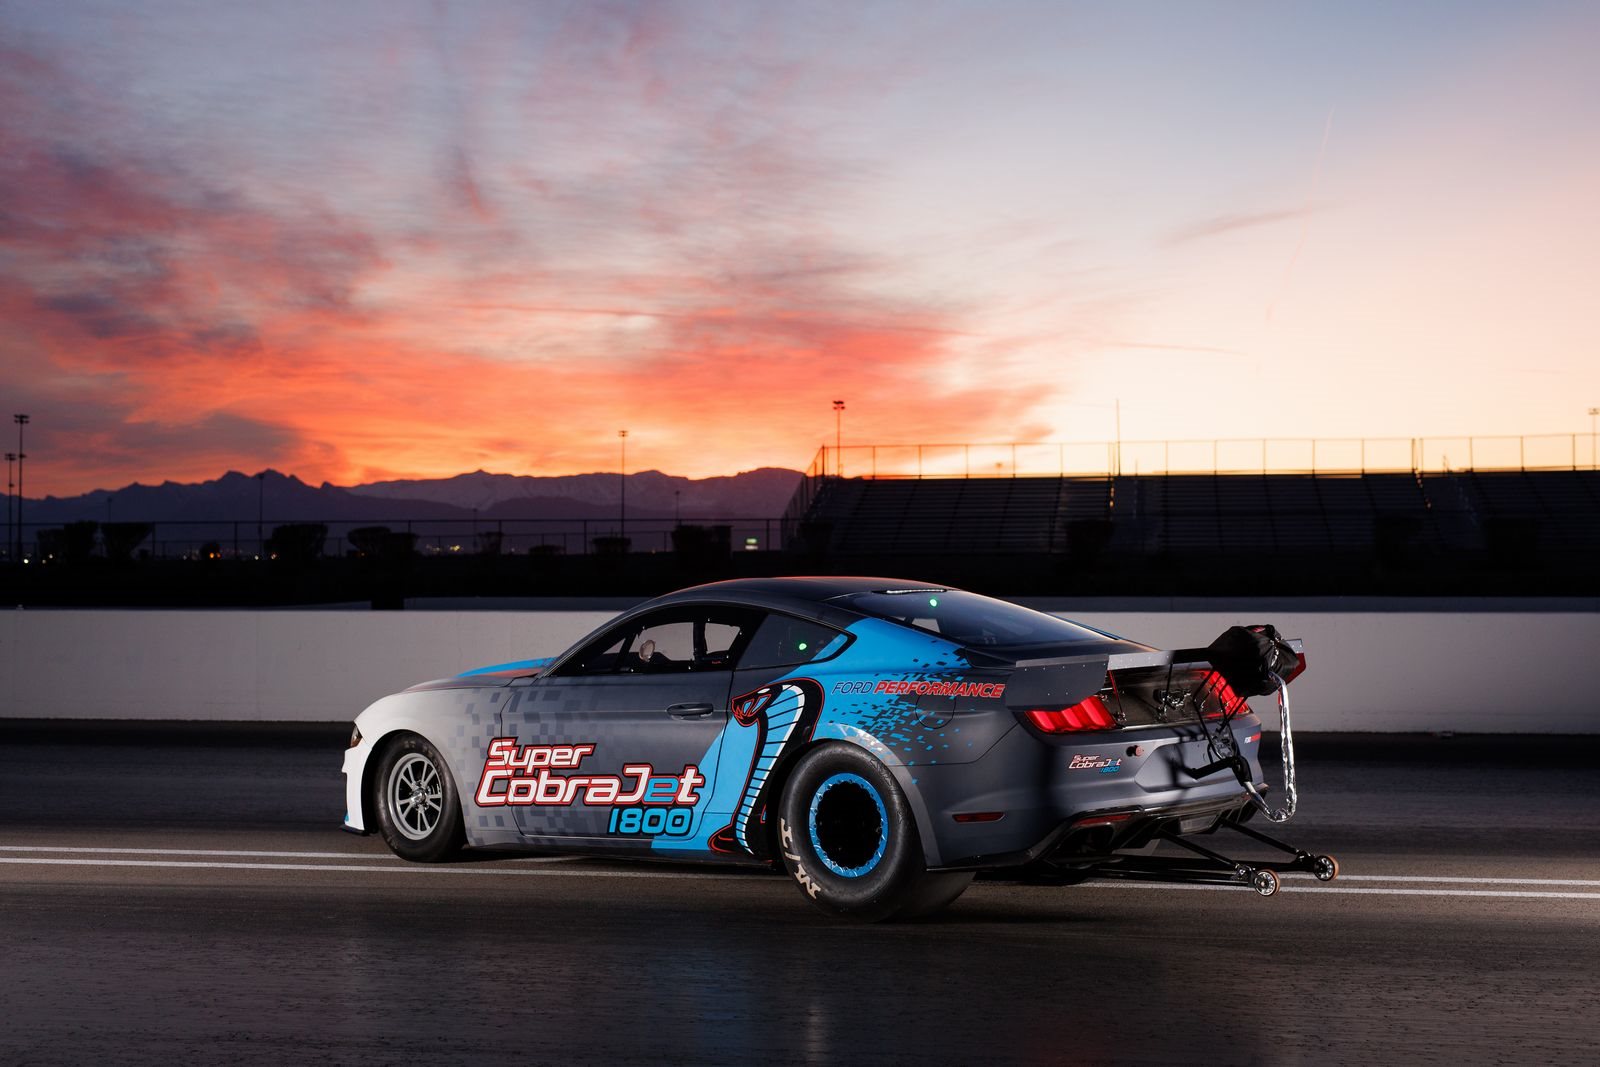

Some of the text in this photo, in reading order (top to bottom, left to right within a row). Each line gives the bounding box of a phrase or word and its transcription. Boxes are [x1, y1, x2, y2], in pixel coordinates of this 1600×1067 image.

[831, 681, 1005, 699] FORD PERFORMANCE
[488, 739, 596, 775] Super
[475, 764, 704, 805] CobraJet
[608, 807, 693, 835] 1800
